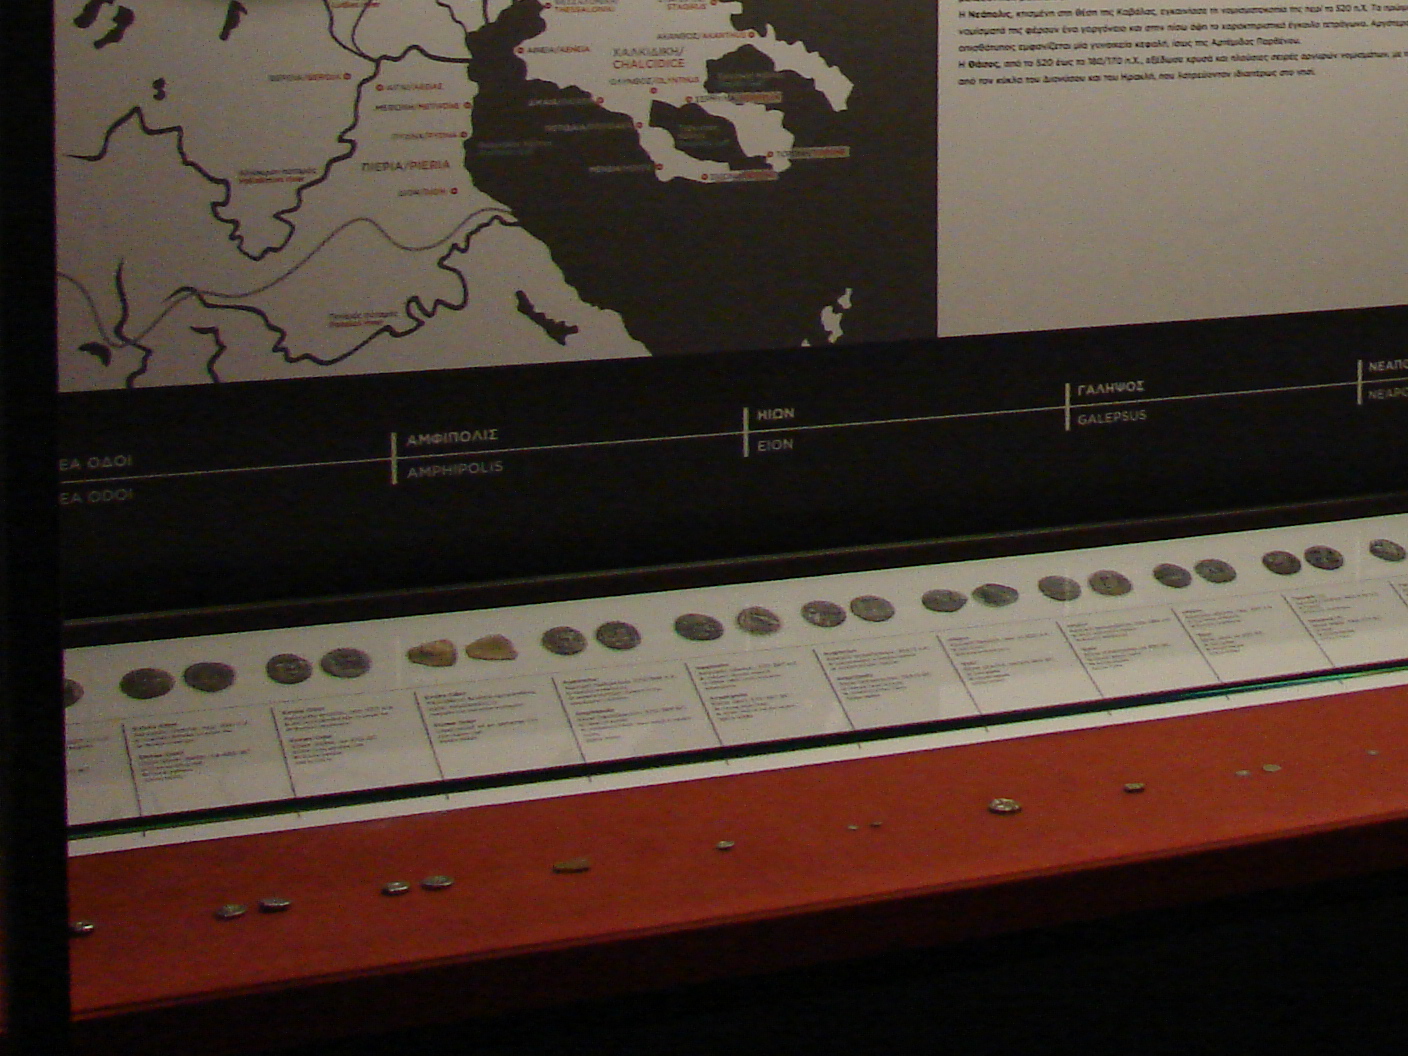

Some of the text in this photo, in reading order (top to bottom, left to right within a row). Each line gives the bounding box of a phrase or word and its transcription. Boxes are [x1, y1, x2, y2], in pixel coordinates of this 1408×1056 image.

[613, 58, 686, 69] CHALCIDICE
[361, 160, 450, 172] ΠΙΕΡΙΑ/PIERIA
[1077, 380, 1146, 397] ΓΑΛΗΨΟΣ
[757, 406, 796, 422] ΗΙΩΝ
[1077, 409, 1147, 426] GALEPSUS
[406, 427, 499, 448] ΑΜΦΙΠΟΛΙΣ
[757, 438, 794, 454] EION
[87, 455, 133, 470] ΟΔΟΙ
[406, 459, 504, 481] AMPHIPOLIS
[87, 488, 134, 502] ODOI
